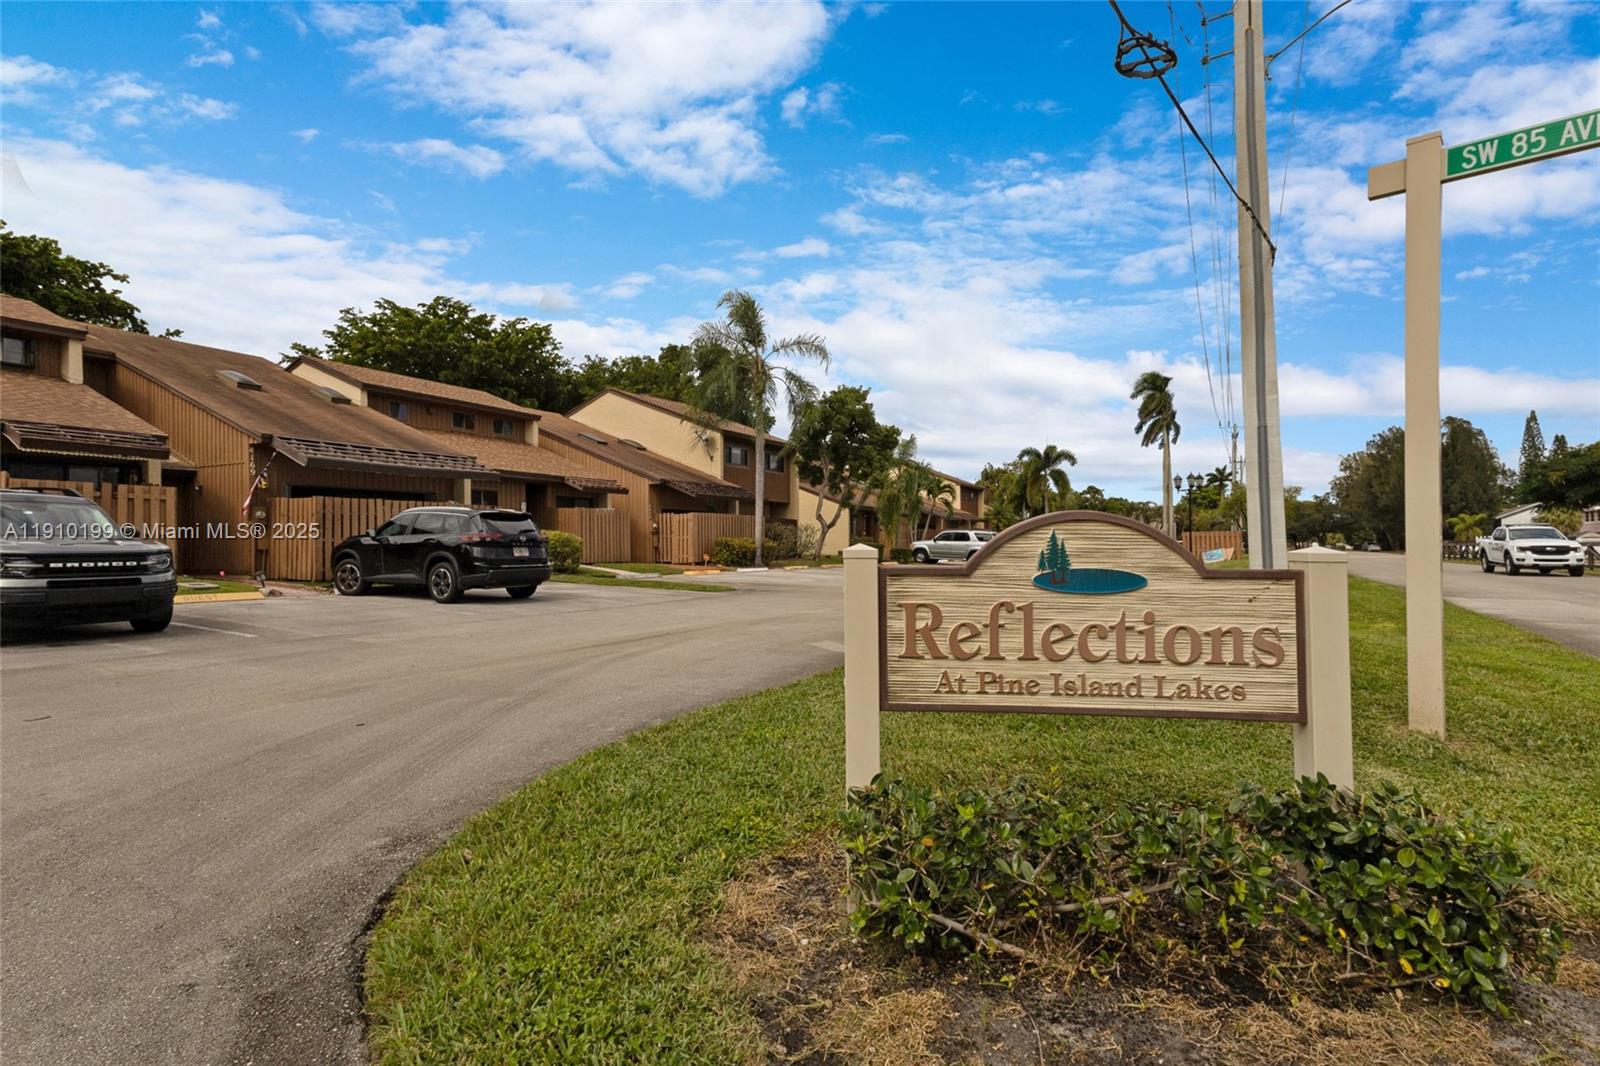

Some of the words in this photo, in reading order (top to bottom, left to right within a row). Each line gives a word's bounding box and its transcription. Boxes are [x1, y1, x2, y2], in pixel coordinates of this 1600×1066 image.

[1462, 141, 1497, 169] SW
[1511, 128, 1547, 156] 85
[897, 600, 1286, 667] Reflections
[934, 670, 967, 694] At
[975, 670, 1041, 696] Pine
[1050, 673, 1143, 698] Island
[1154, 675, 1247, 702] Lakes
